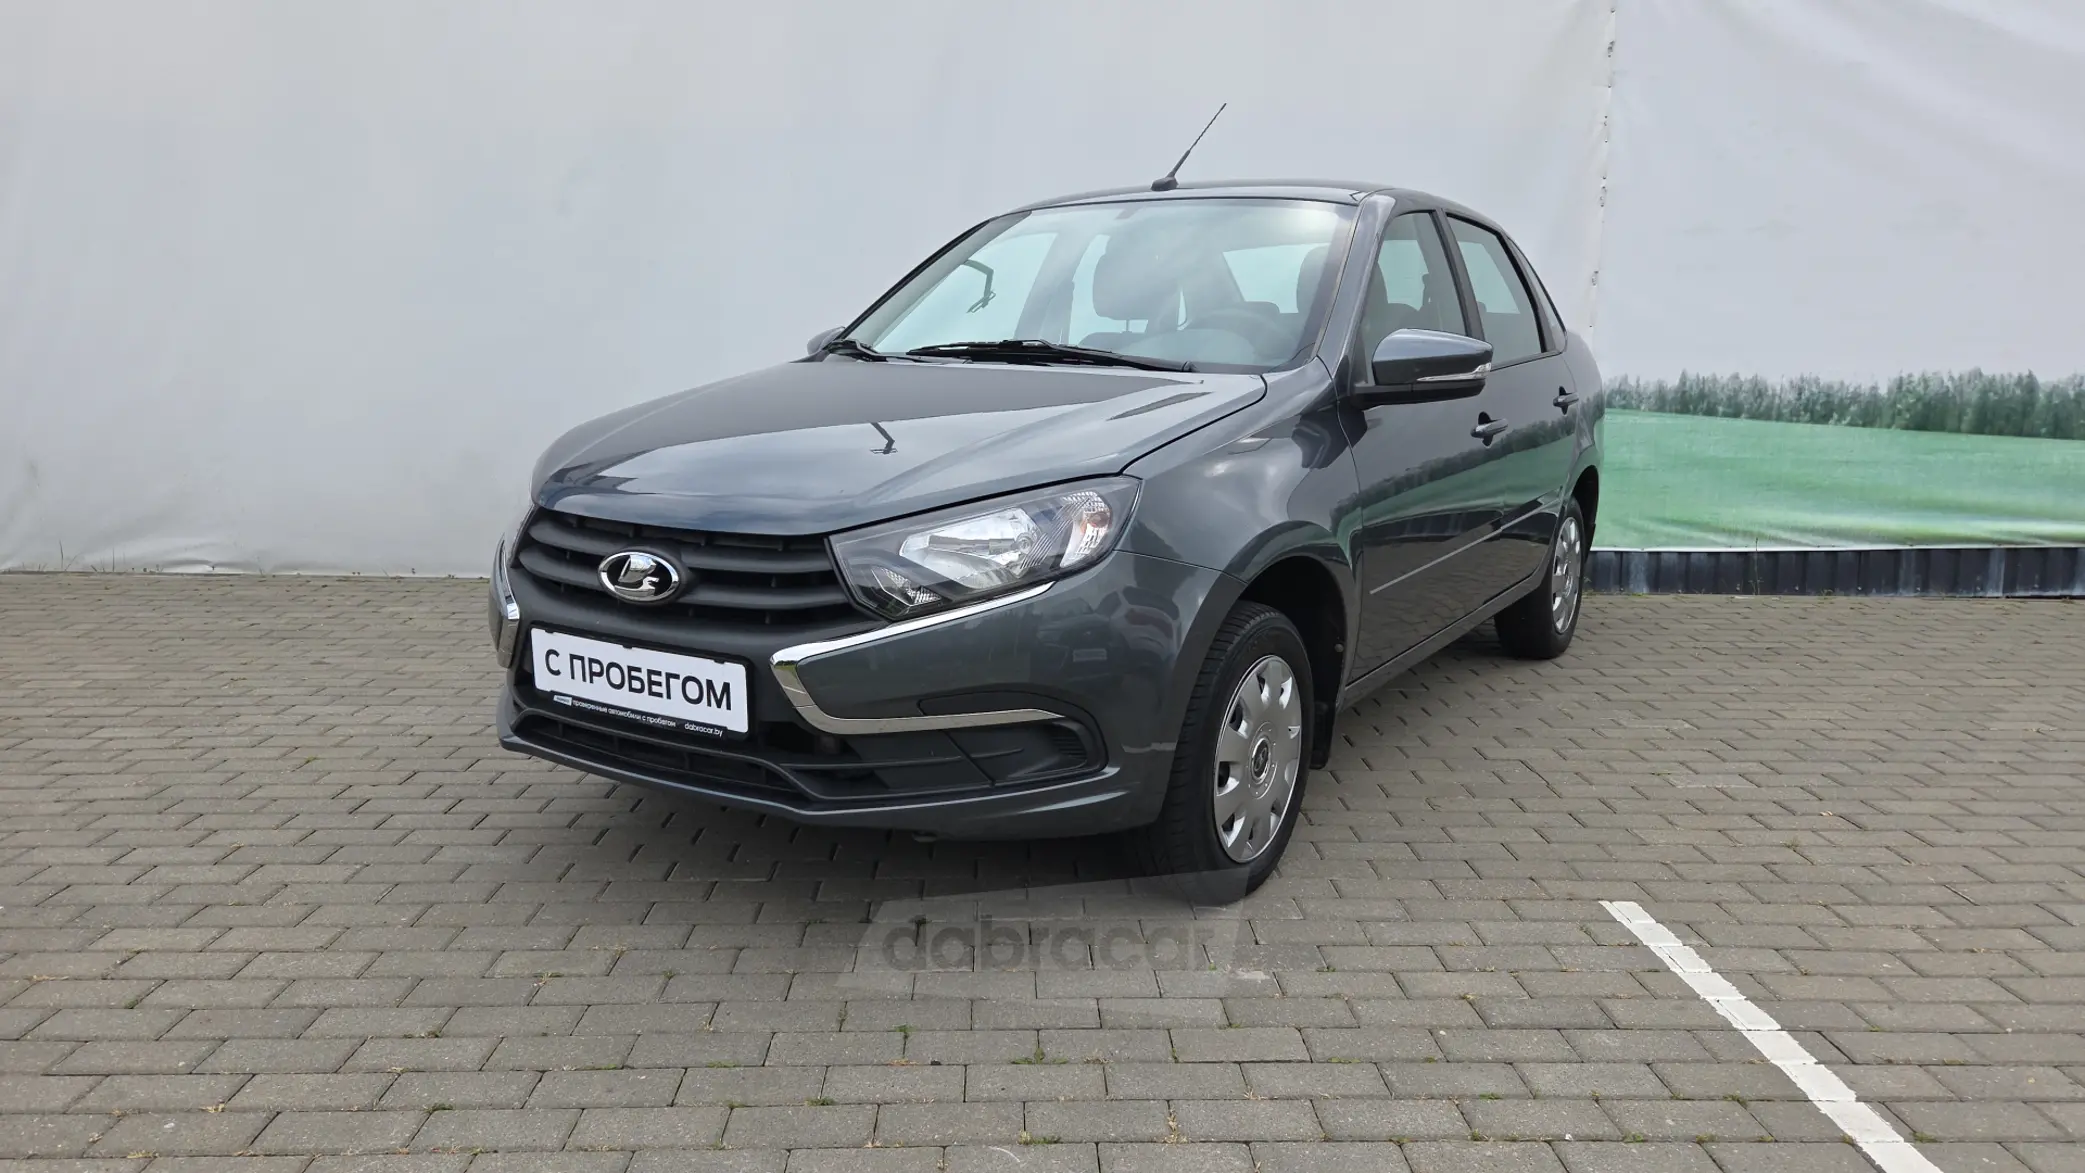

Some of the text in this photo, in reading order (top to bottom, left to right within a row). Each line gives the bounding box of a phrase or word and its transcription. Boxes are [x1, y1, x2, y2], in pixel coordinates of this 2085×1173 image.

[545, 648, 732, 711] С ПРОБЕГОМ
[647, 715, 676, 728] пробегом
[684, 722, 723, 738] dabracar.by
